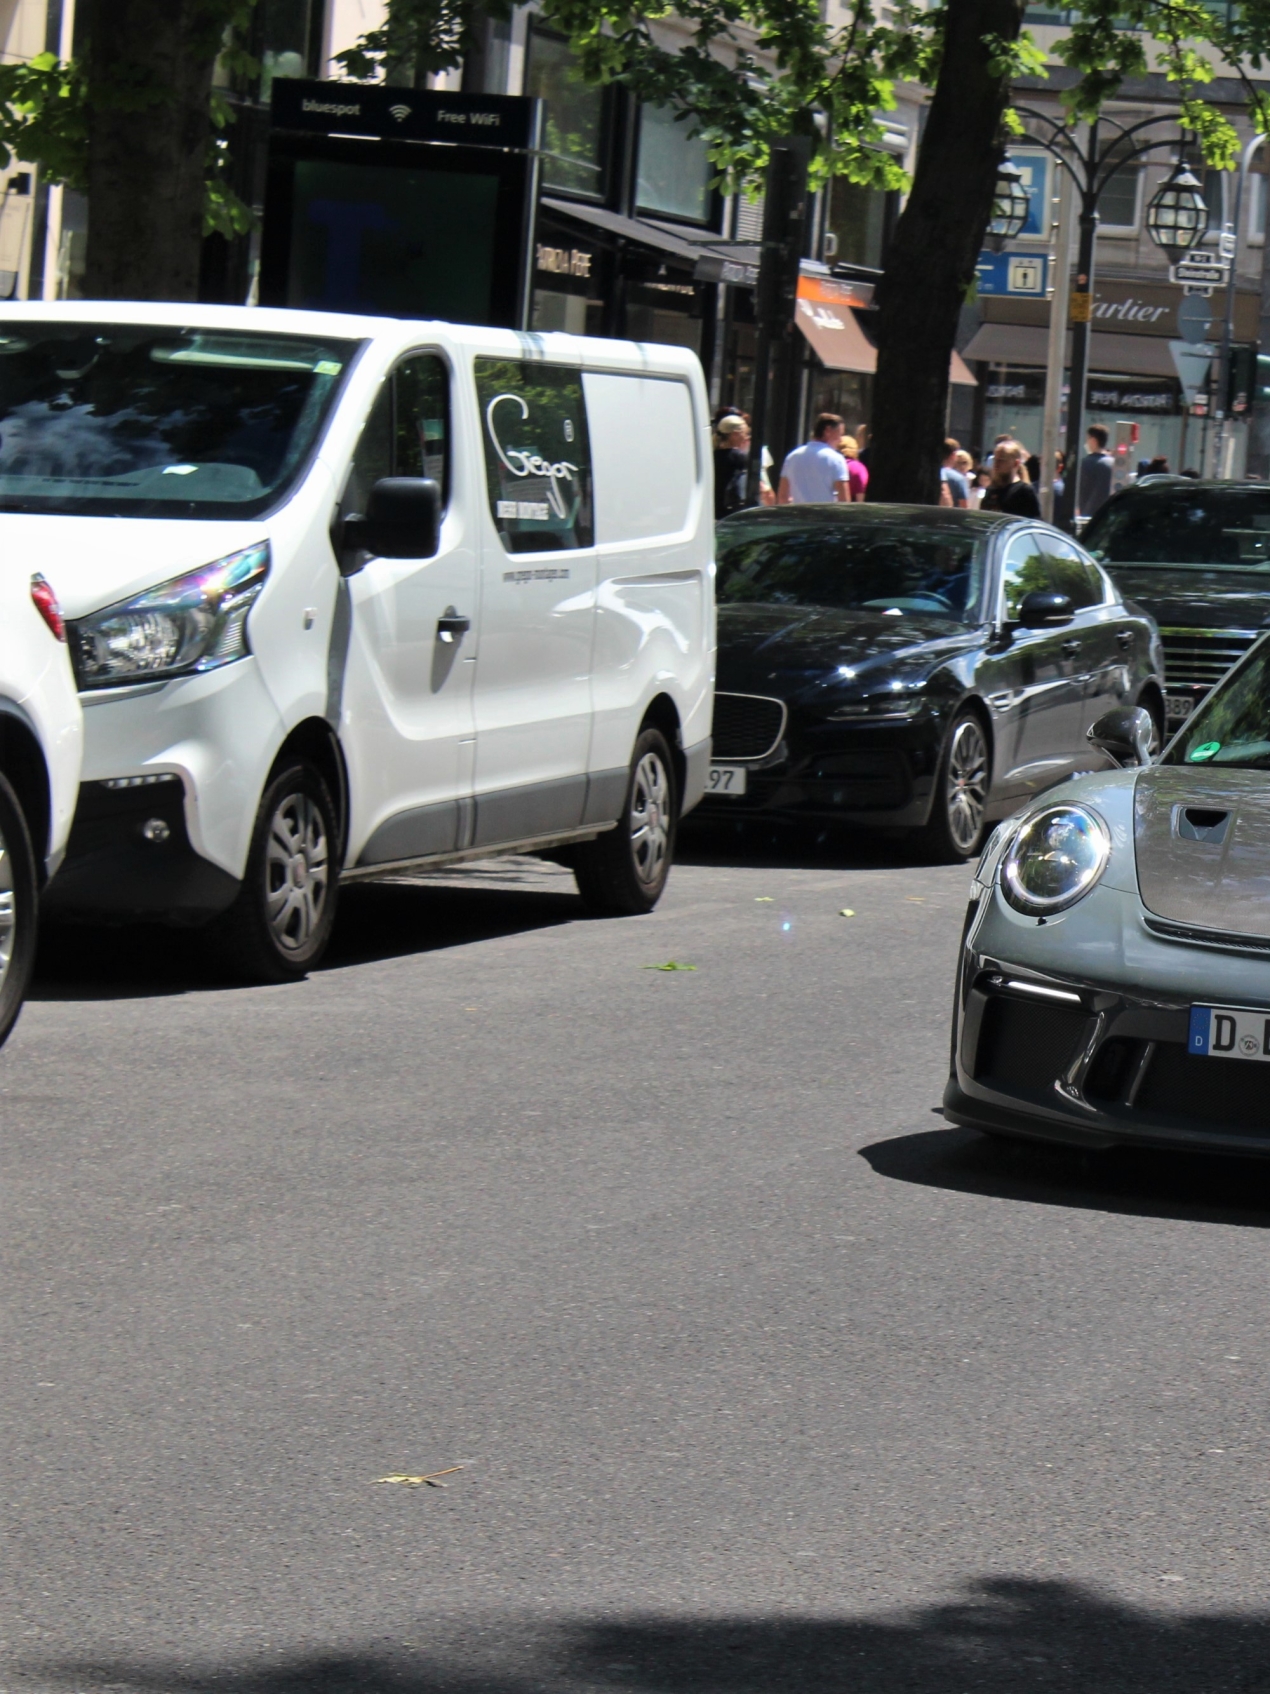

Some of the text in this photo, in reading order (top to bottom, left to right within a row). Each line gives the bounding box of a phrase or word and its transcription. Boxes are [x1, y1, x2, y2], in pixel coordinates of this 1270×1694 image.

[302, 99, 361, 116] bluespot
[437, 110, 500, 126] Free WiFi
[1090, 293, 1170, 323] artier
[1212, 1014, 1237, 1052] D
